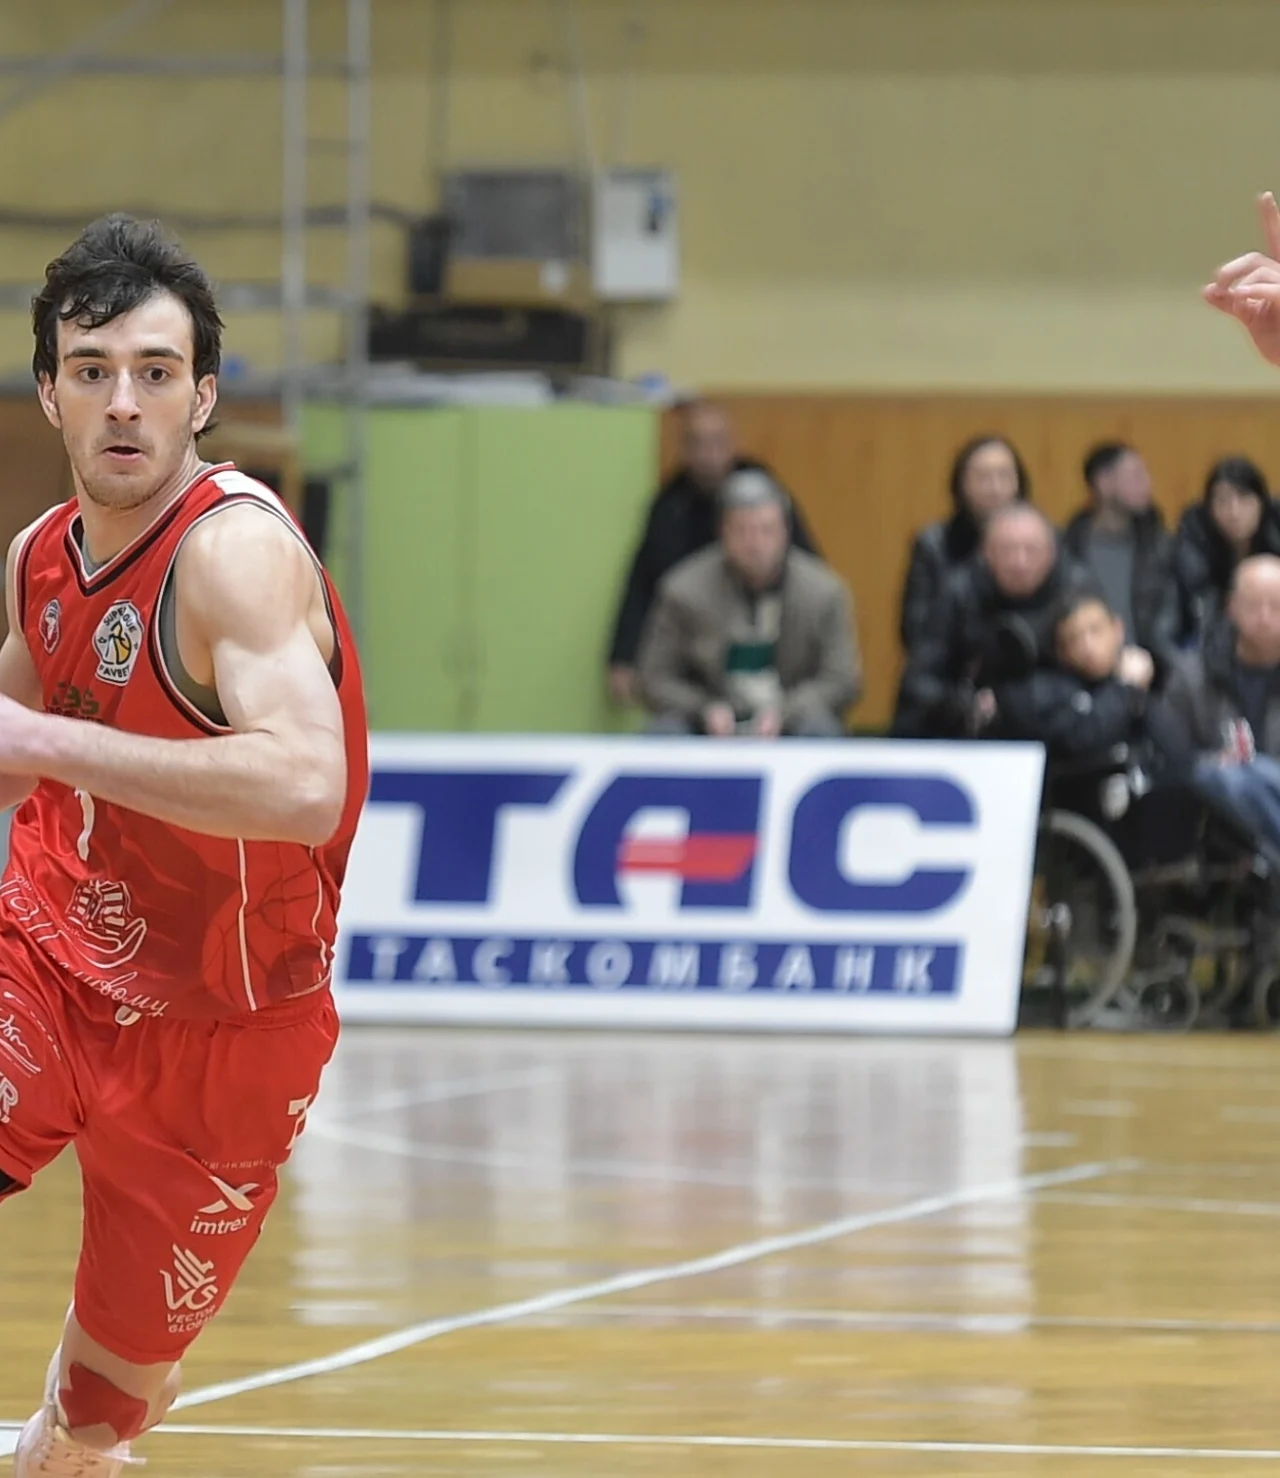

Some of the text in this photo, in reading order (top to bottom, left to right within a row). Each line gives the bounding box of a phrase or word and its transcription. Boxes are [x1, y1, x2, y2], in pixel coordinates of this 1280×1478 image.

[368, 769, 979, 919] ТАС
[368, 936, 936, 993] ТАСКОМБАНК
[190, 1215, 250, 1235] imtrex
